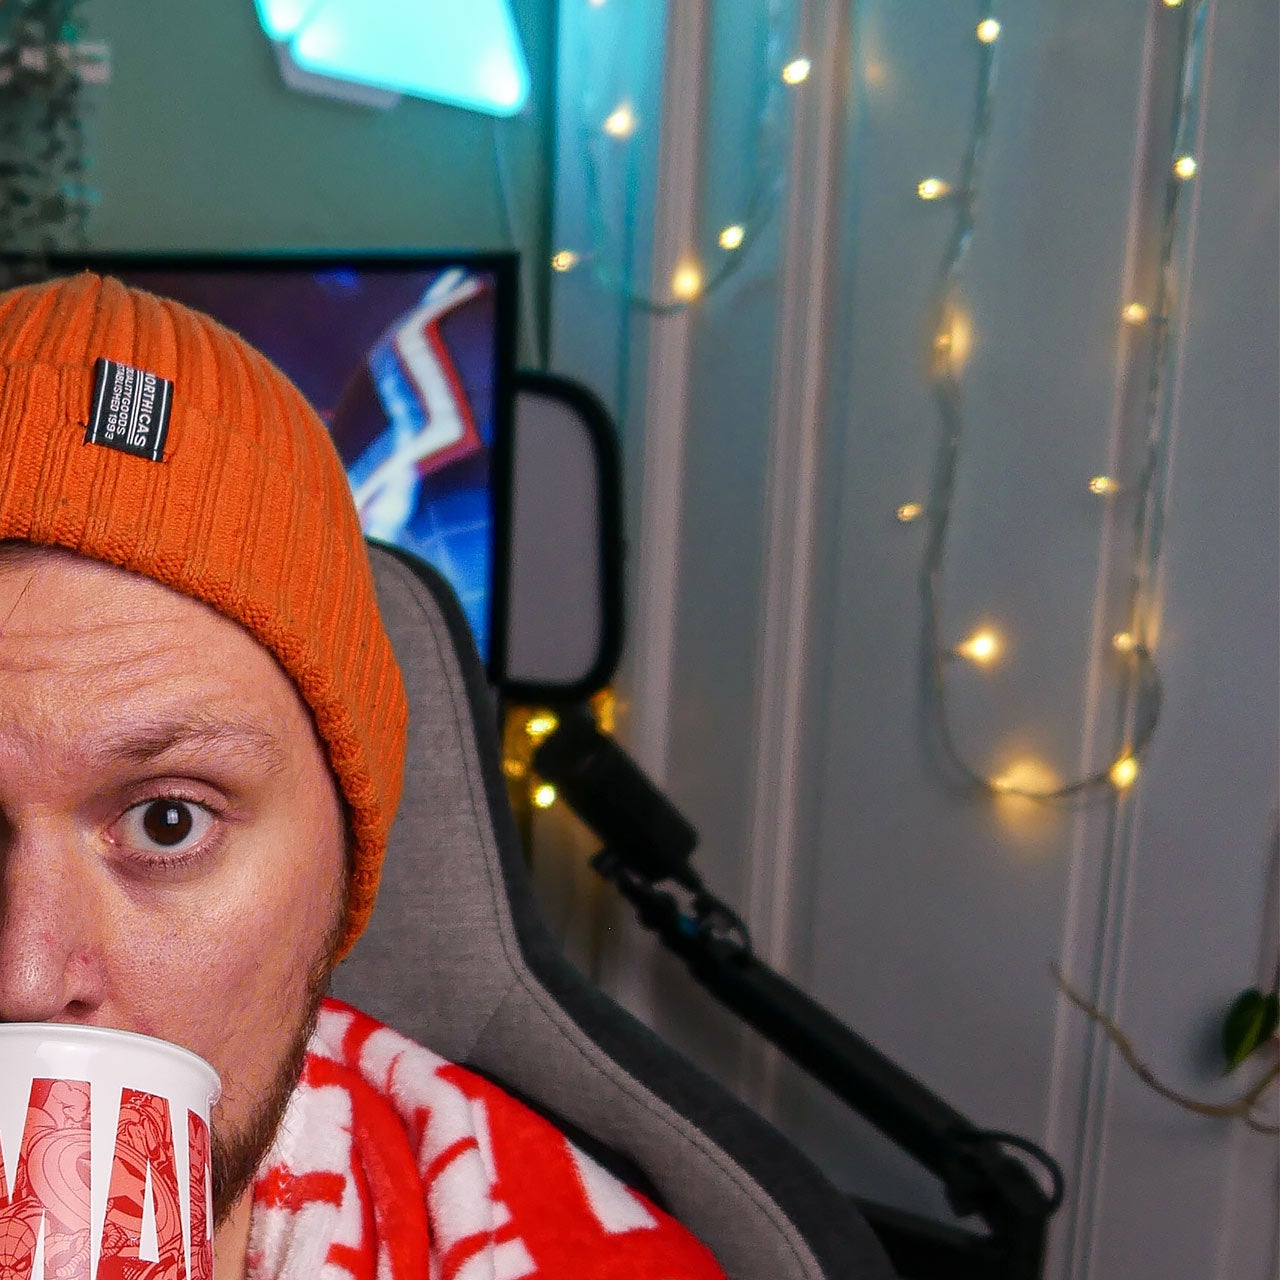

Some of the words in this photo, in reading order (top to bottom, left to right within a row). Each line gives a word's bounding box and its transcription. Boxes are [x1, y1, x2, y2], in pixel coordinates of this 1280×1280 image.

[110, 362, 125, 411] STABLISHED
[105, 413, 117, 440] 1993
[117, 398, 131, 435] GOODS
